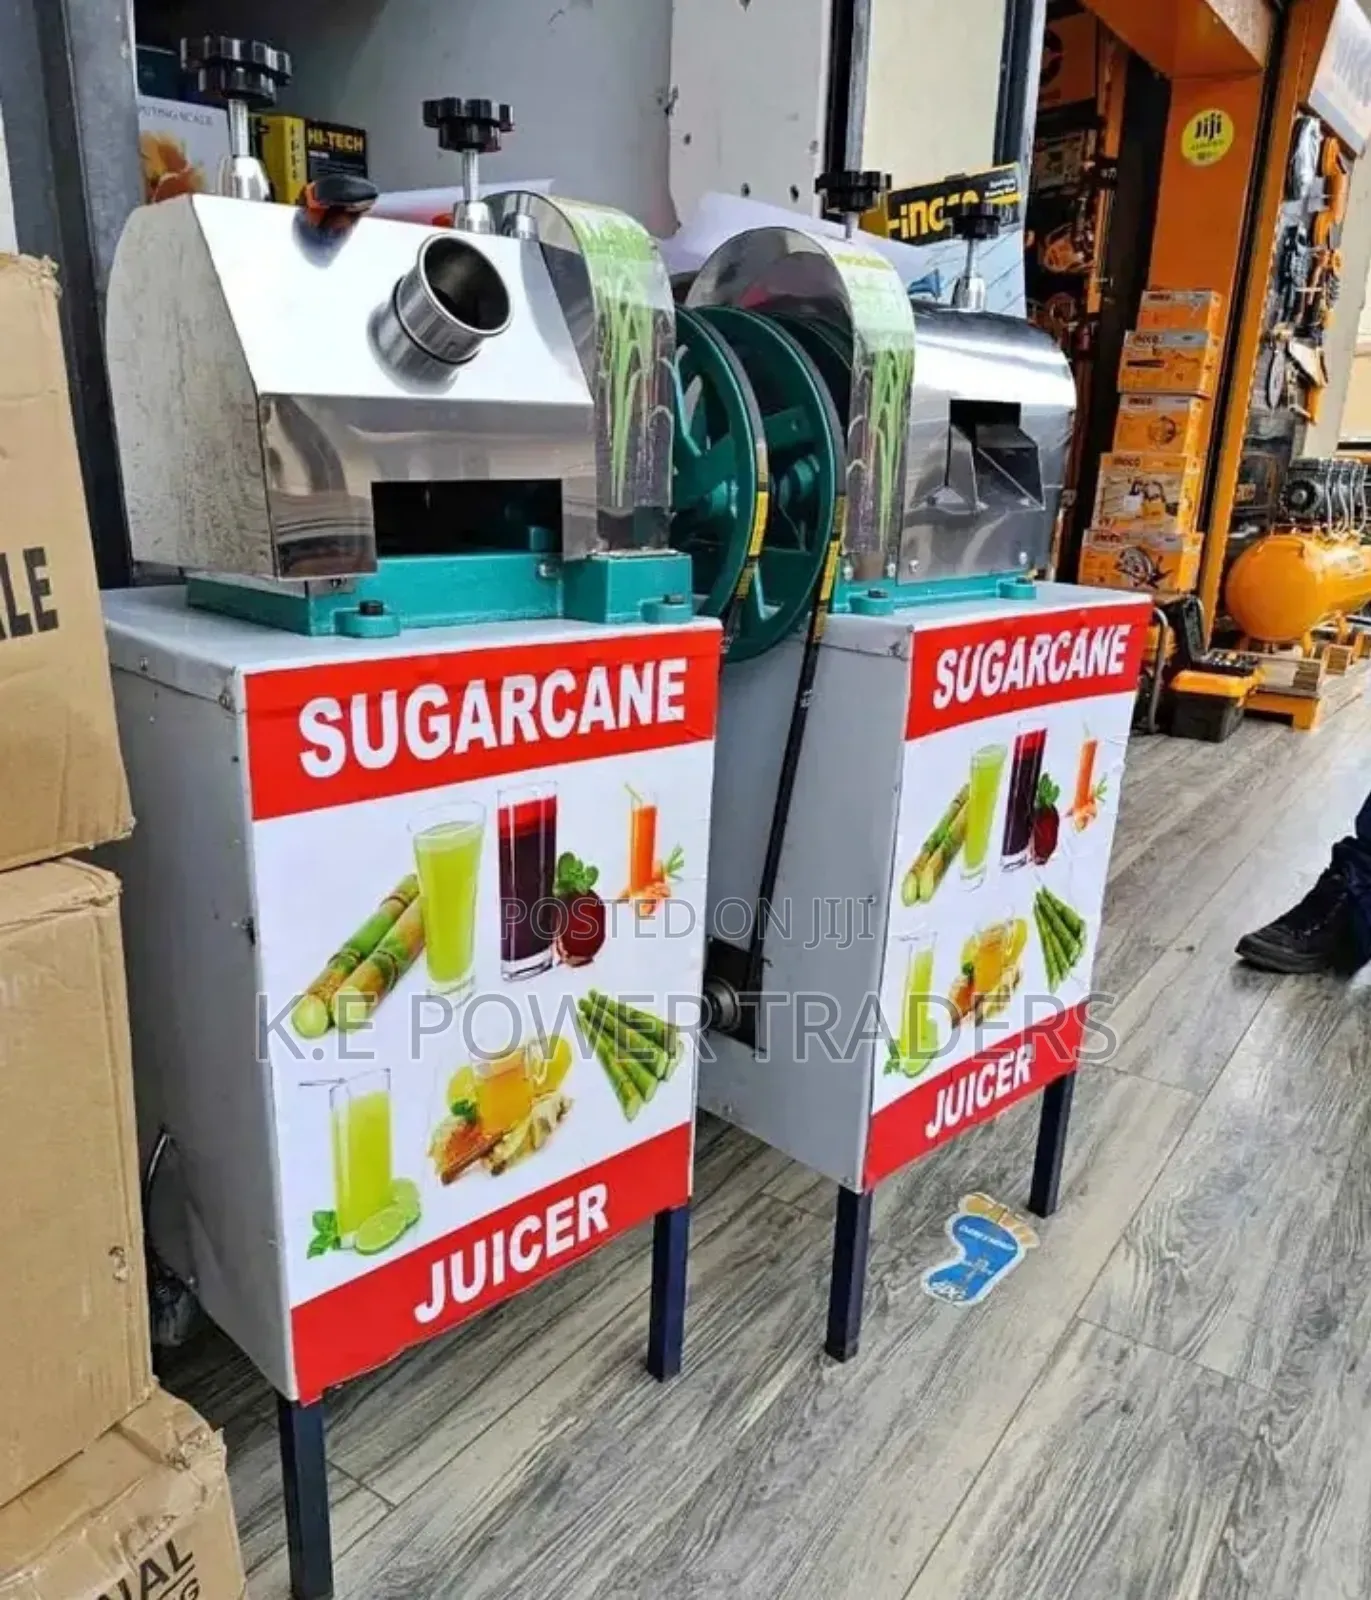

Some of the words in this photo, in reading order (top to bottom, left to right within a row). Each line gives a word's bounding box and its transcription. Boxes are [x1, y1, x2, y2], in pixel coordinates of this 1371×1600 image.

[307, 128, 364, 152] HI-TECH
[0, 546, 60, 640] LE
[932, 624, 1131, 710] SUGARCANE
[299, 658, 688, 778] SUGARCANE
[925, 1043, 1034, 1139] JUICER
[414, 1183, 609, 1324] JUICER
